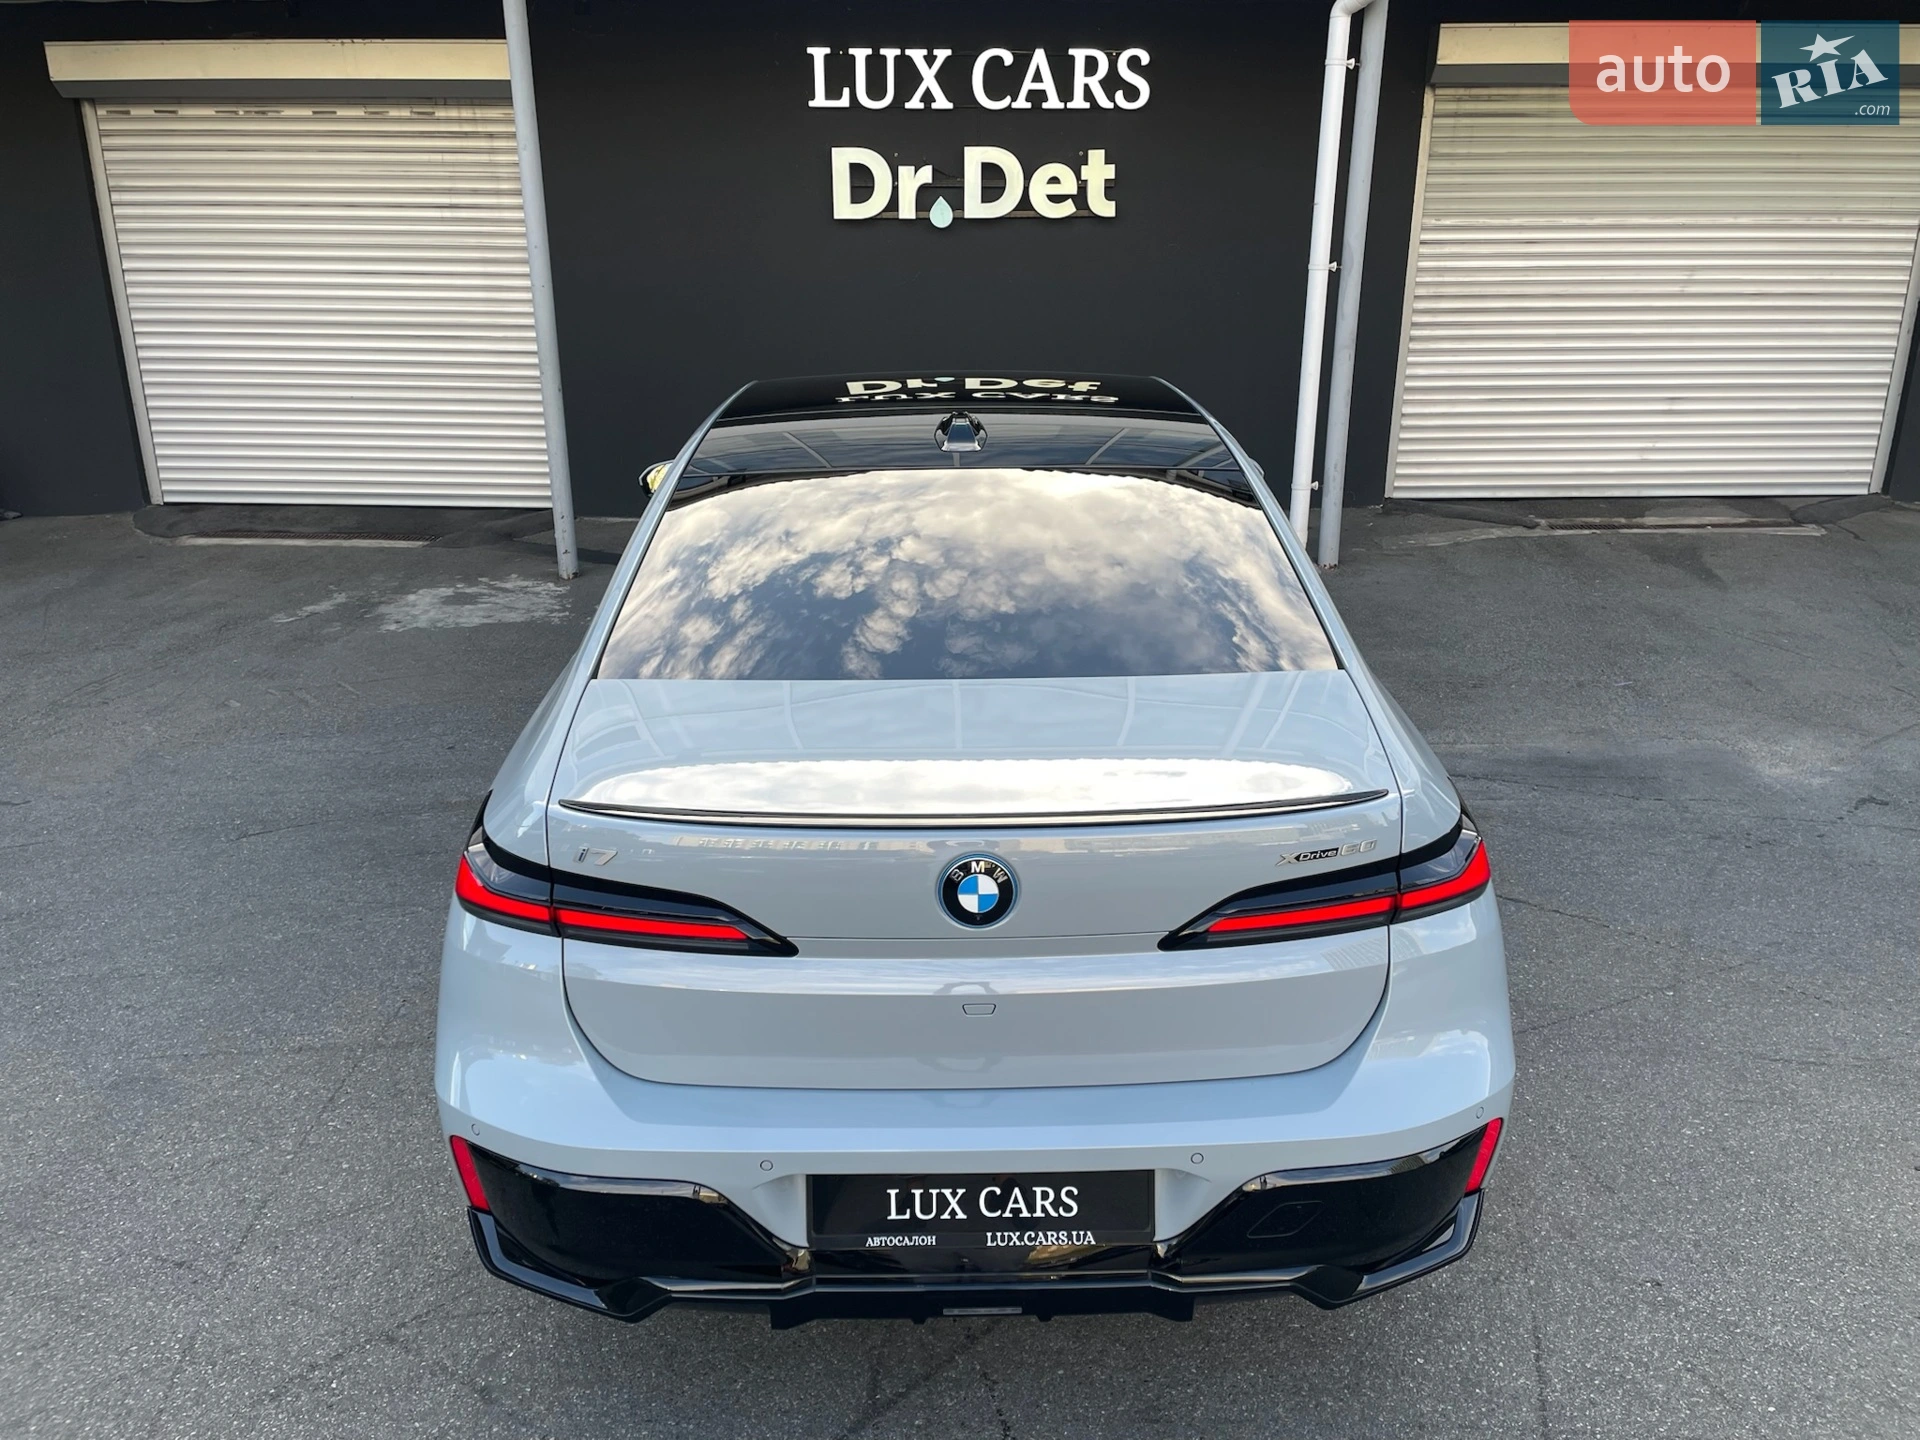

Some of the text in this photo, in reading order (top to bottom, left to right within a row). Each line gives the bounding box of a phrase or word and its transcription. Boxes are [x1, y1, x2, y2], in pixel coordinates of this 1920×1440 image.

[806, 46, 1151, 111] LUX CARS
[572, 845, 619, 867] i7
[949, 859, 1009, 884] BMW
[886, 1186, 1079, 1220] LUX CARS
[865, 1235, 937, 1248] АВТОСАЛОН
[986, 1230, 1096, 1247] LUX.CARS.UA
